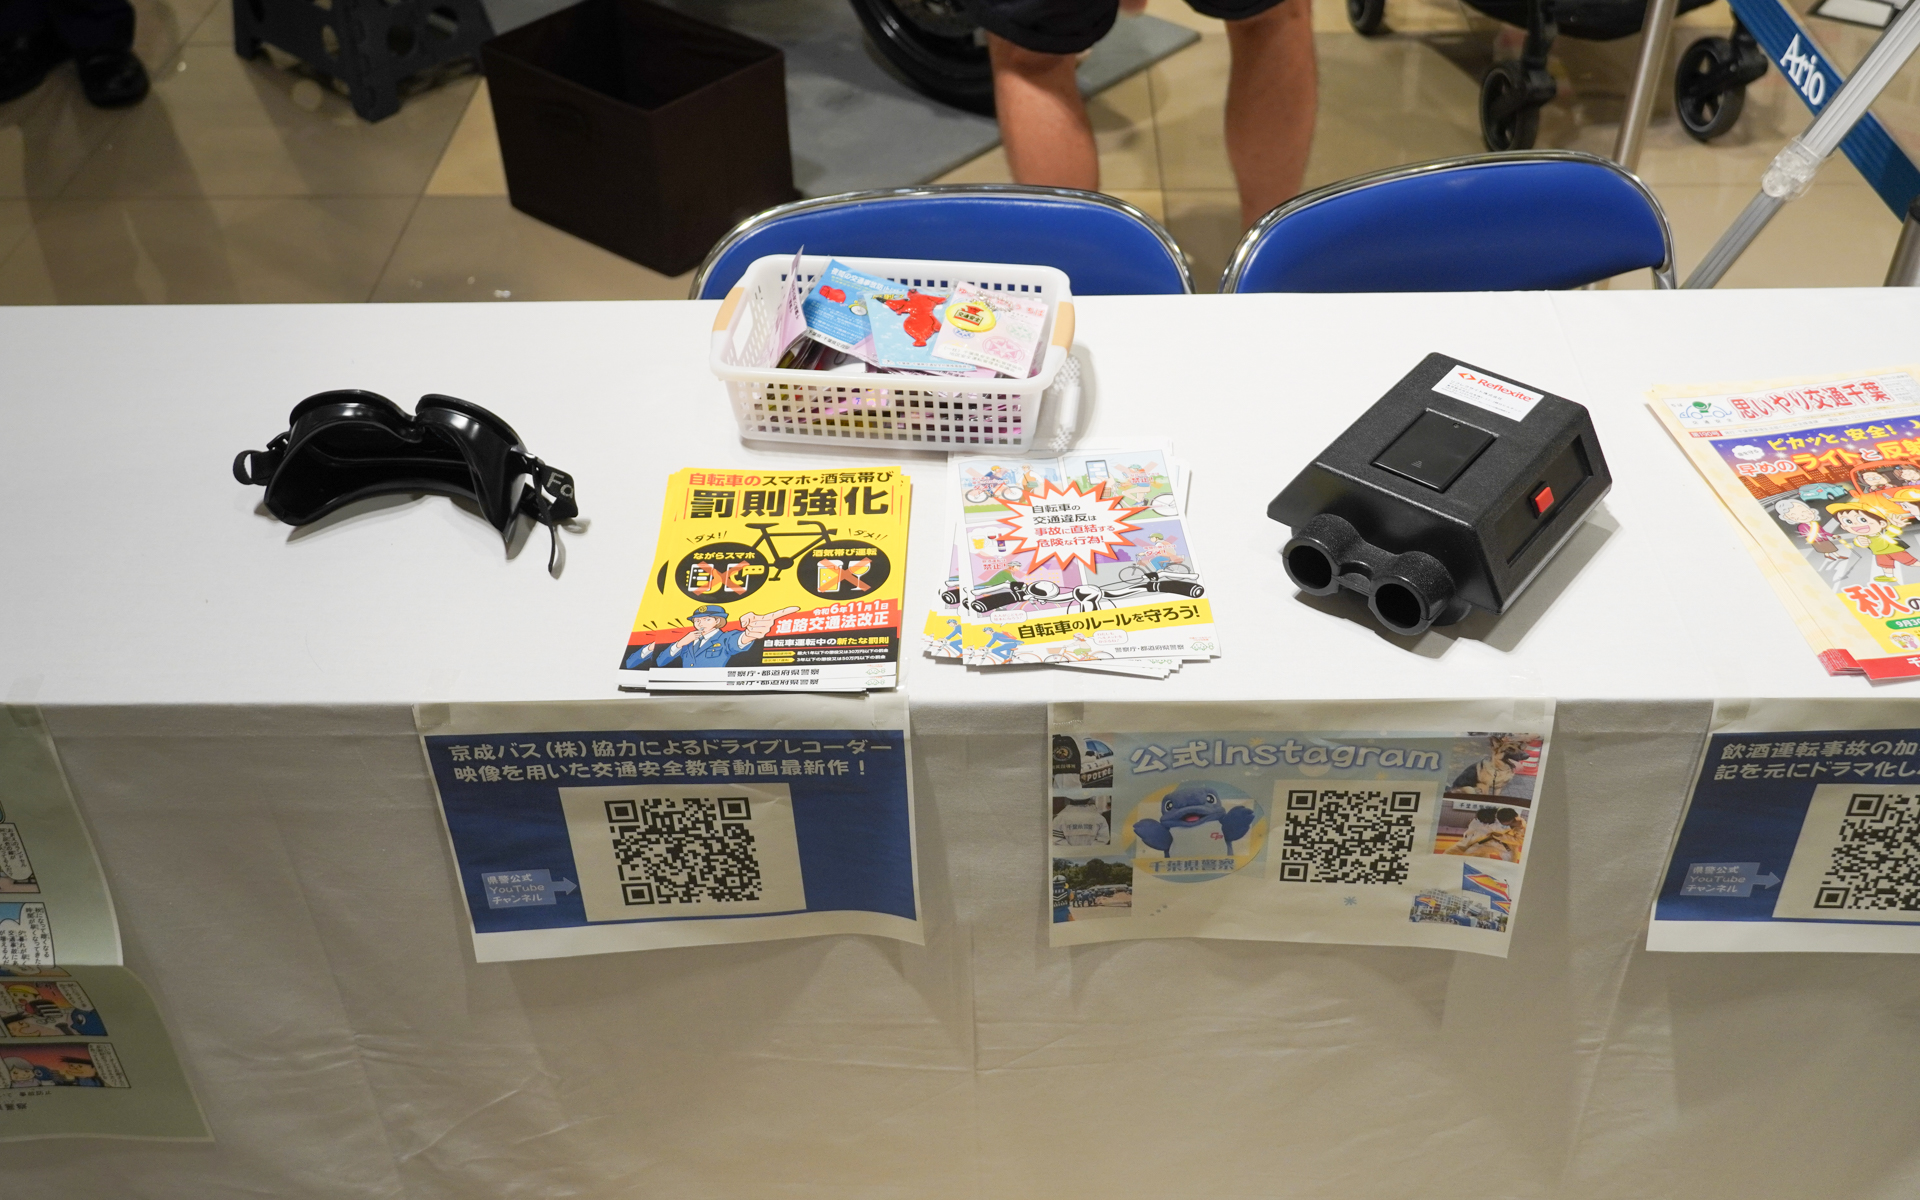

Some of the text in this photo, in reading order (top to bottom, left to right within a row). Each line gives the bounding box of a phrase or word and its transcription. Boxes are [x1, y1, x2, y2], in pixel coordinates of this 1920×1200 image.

[1780, 33, 1825, 105] Ario
[958, 311, 980, 322] 交通安全
[1477, 379, 1531, 402] Reflexite
[1730, 381, 1892, 419] 思いやり交通千葉
[1768, 424, 1898, 452] ピカッと、安全！
[689, 471, 894, 488] 自転車のスマホ・酒気帯び
[690, 486, 889, 518] 罰則強化
[1032, 504, 1080, 514] 自転車の
[1033, 514, 1097, 525] 交通違反は
[1034, 524, 1115, 537] 事故に直結する
[1036, 536, 1104, 548] 危険な行為！
[692, 551, 755, 560] ながらスマホ
[812, 547, 878, 557] 酒気帯び運転
[1843, 583, 1920, 617] 秋の
[813, 601, 889, 616] 令和6年11月1日
[775, 611, 889, 634] 道路交通法改正
[1018, 605, 1200, 639] 自転車のルールを守ろう！
[763, 637, 889, 648] 自転車運転中の新たな罰則
[727, 668, 820, 677] 警察庁・都道府県警察
[448, 738, 893, 762] 京成バス（株）協力によるドライブレコーダー
[1131, 738, 1442, 775] 公式Instagram
[1721, 739, 1919, 760] 飲酒運転事故の加
[454, 758, 867, 783] 映像を用いた交通安全教育動画最新作！
[1714, 761, 1920, 781] 記を元にドラマ化し
[1149, 857, 1236, 874] 千葉県警察
[1693, 865, 1740, 875] 県警公式
[487, 873, 533, 885] 県警公式
[1690, 875, 1746, 884] YouTube
[489, 883, 545, 895] YouTube
[1686, 884, 1738, 894] チャンネル
[492, 893, 543, 905] チャンネル
